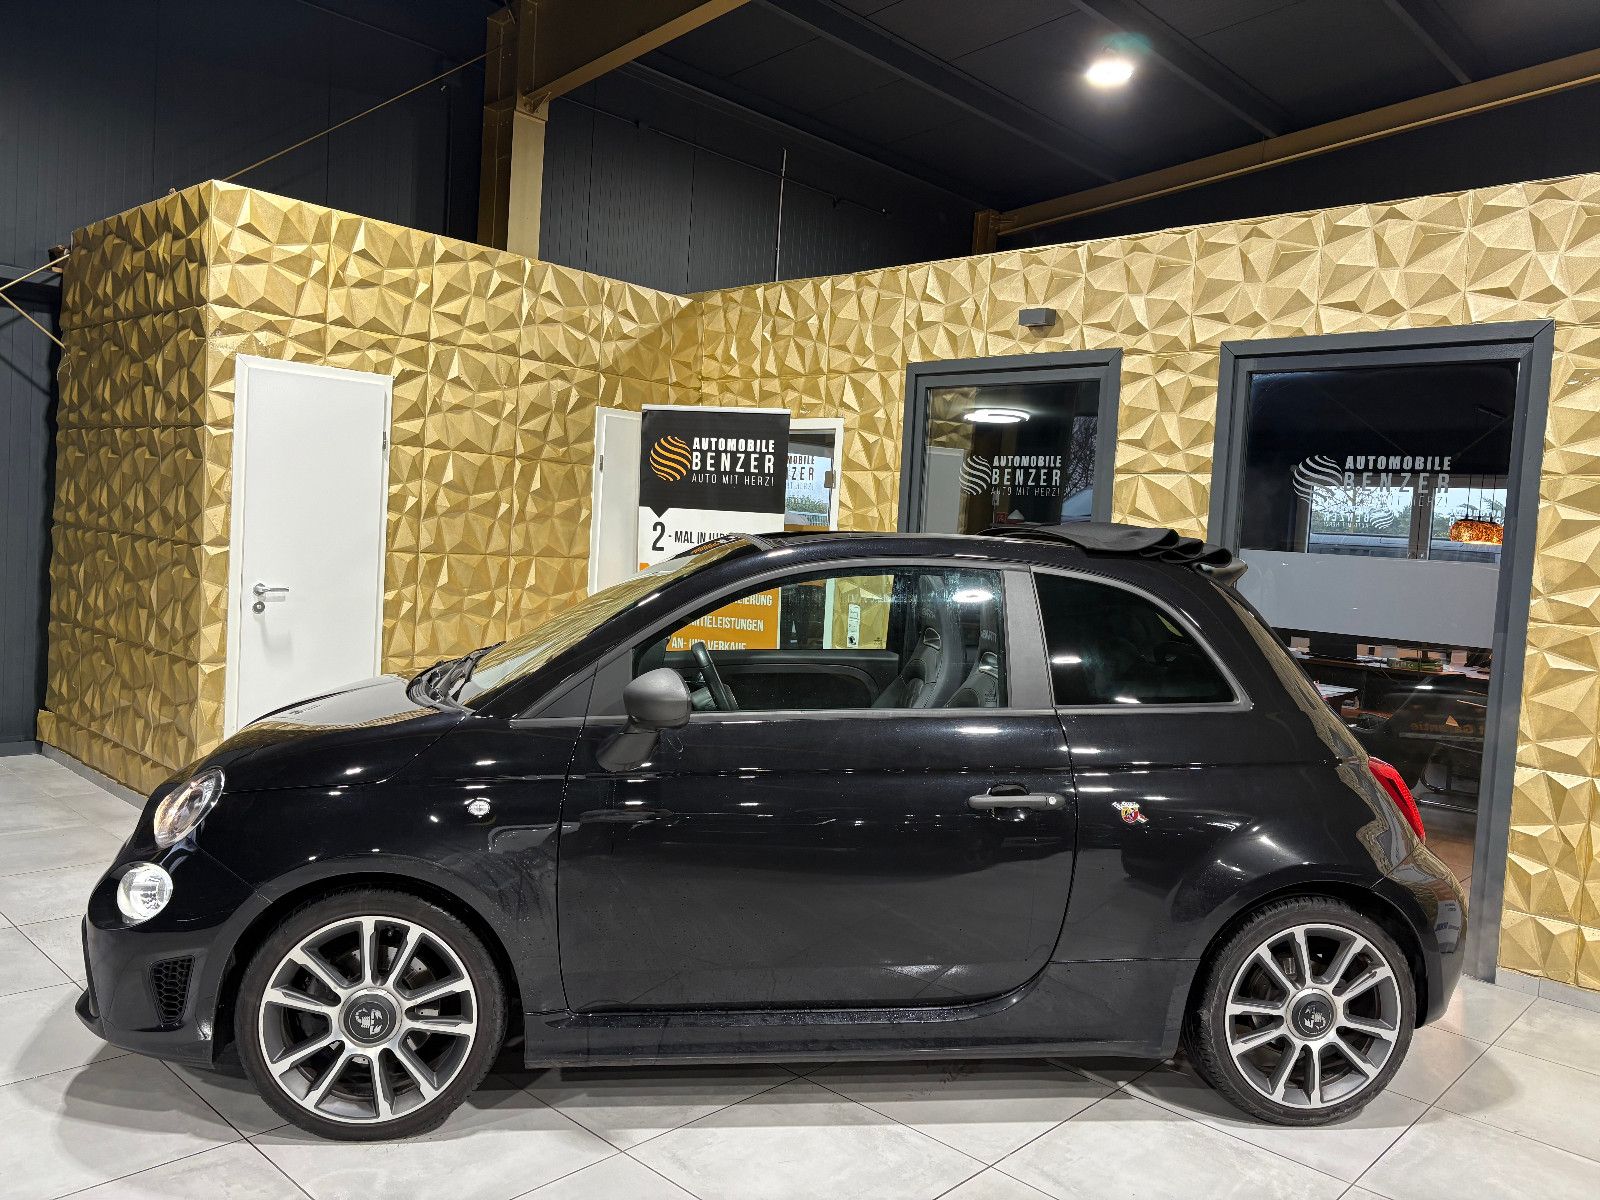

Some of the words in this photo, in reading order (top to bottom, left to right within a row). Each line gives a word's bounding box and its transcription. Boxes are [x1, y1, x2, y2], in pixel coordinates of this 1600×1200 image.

[692, 437, 775, 453] AUTOMOBILE
[692, 451, 775, 474] BENZER
[992, 455, 1062, 467] AUTOMOBILE
[1345, 455, 1452, 471] AUTOMOBILE
[691, 473, 717, 484] AUTO
[722, 474, 739, 485] MIT
[744, 475, 774, 487] HERZ!
[991, 468, 1061, 486] BENZER
[1343, 471, 1450, 494] BENZER
[1015, 487, 1030, 496] MIT
[1034, 487, 1060, 497] HERZ!
[652, 521, 666, 551] 2
[674, 531, 695, 544] MAL
[697, 531, 706, 544] IN
[671, 636, 687, 649] AN-
